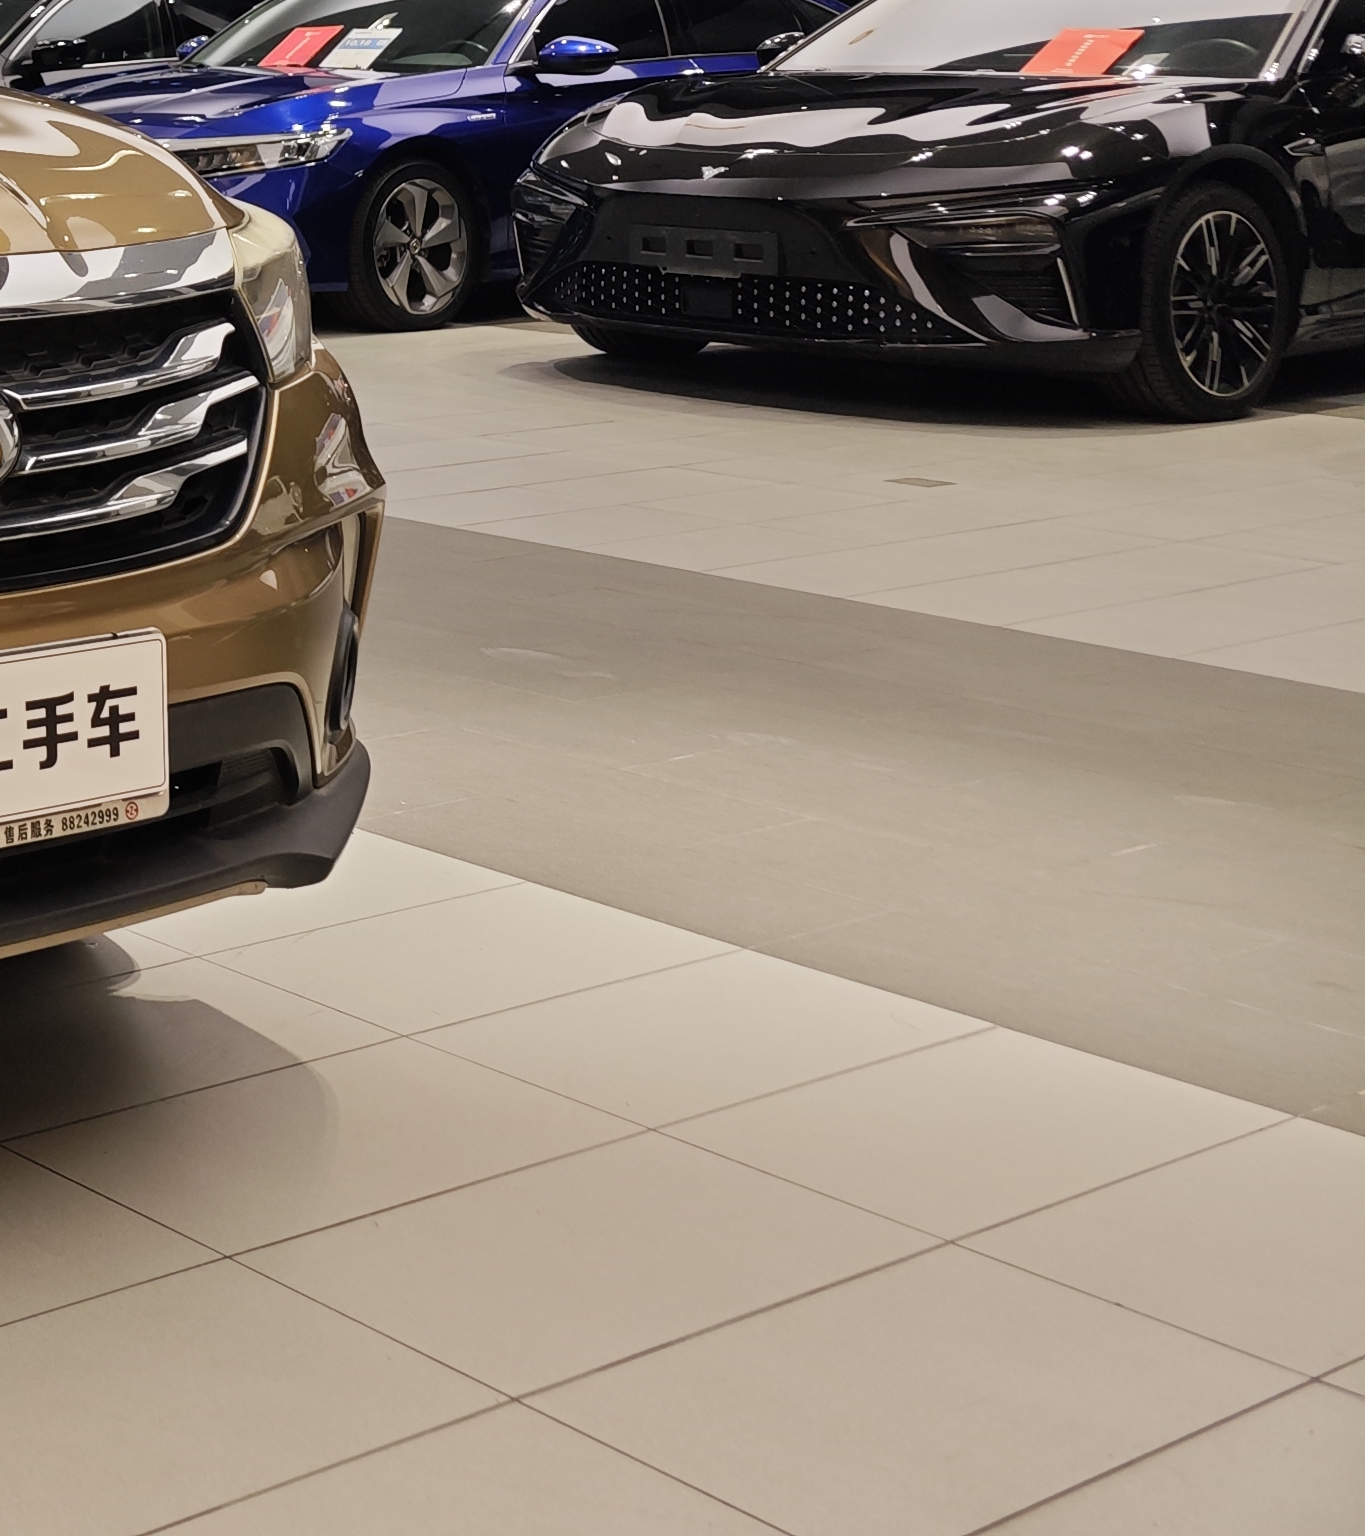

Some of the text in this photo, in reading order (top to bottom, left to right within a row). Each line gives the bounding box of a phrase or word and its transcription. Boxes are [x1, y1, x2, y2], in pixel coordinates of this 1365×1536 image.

[4, 818, 55, 845] 售后服务
[61, 806, 119, 832] 88242999
